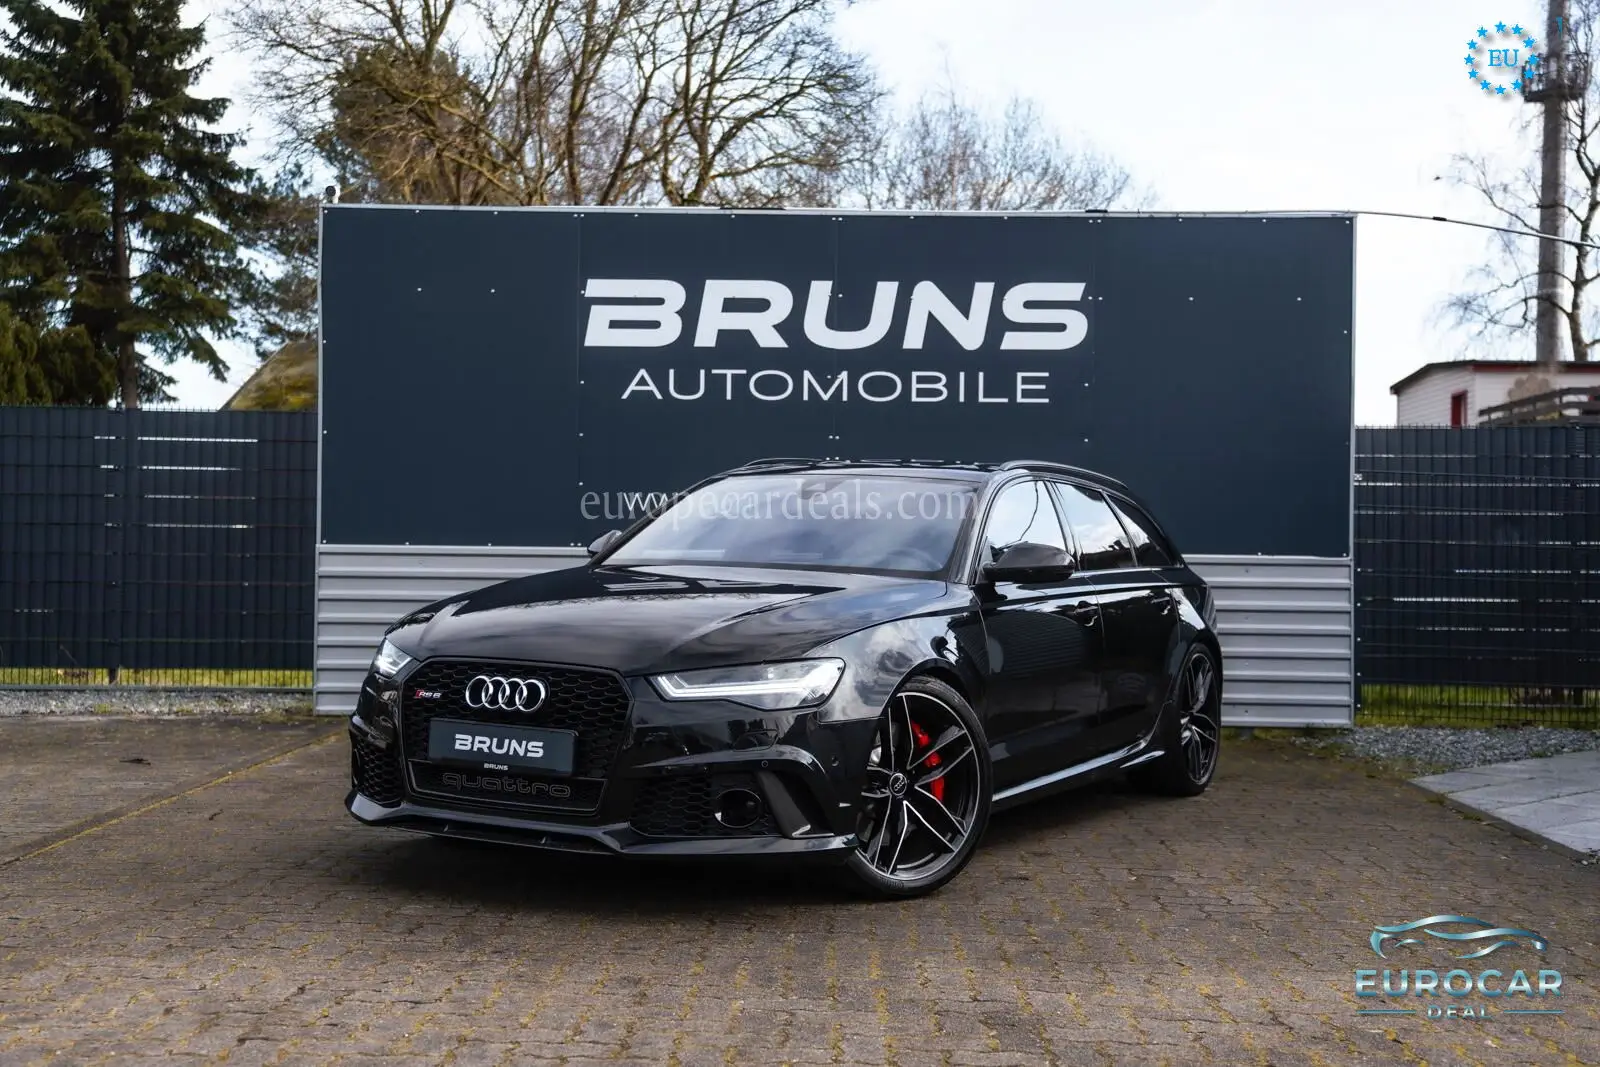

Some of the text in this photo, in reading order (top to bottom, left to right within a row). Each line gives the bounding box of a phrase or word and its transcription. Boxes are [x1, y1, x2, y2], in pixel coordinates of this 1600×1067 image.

[584, 278, 1088, 350] BRUNS
[621, 368, 1050, 403] AUTOMOBILE
[454, 733, 545, 758] BRUNS
[483, 762, 509, 771] BRUNS
[442, 772, 571, 798] quattro
